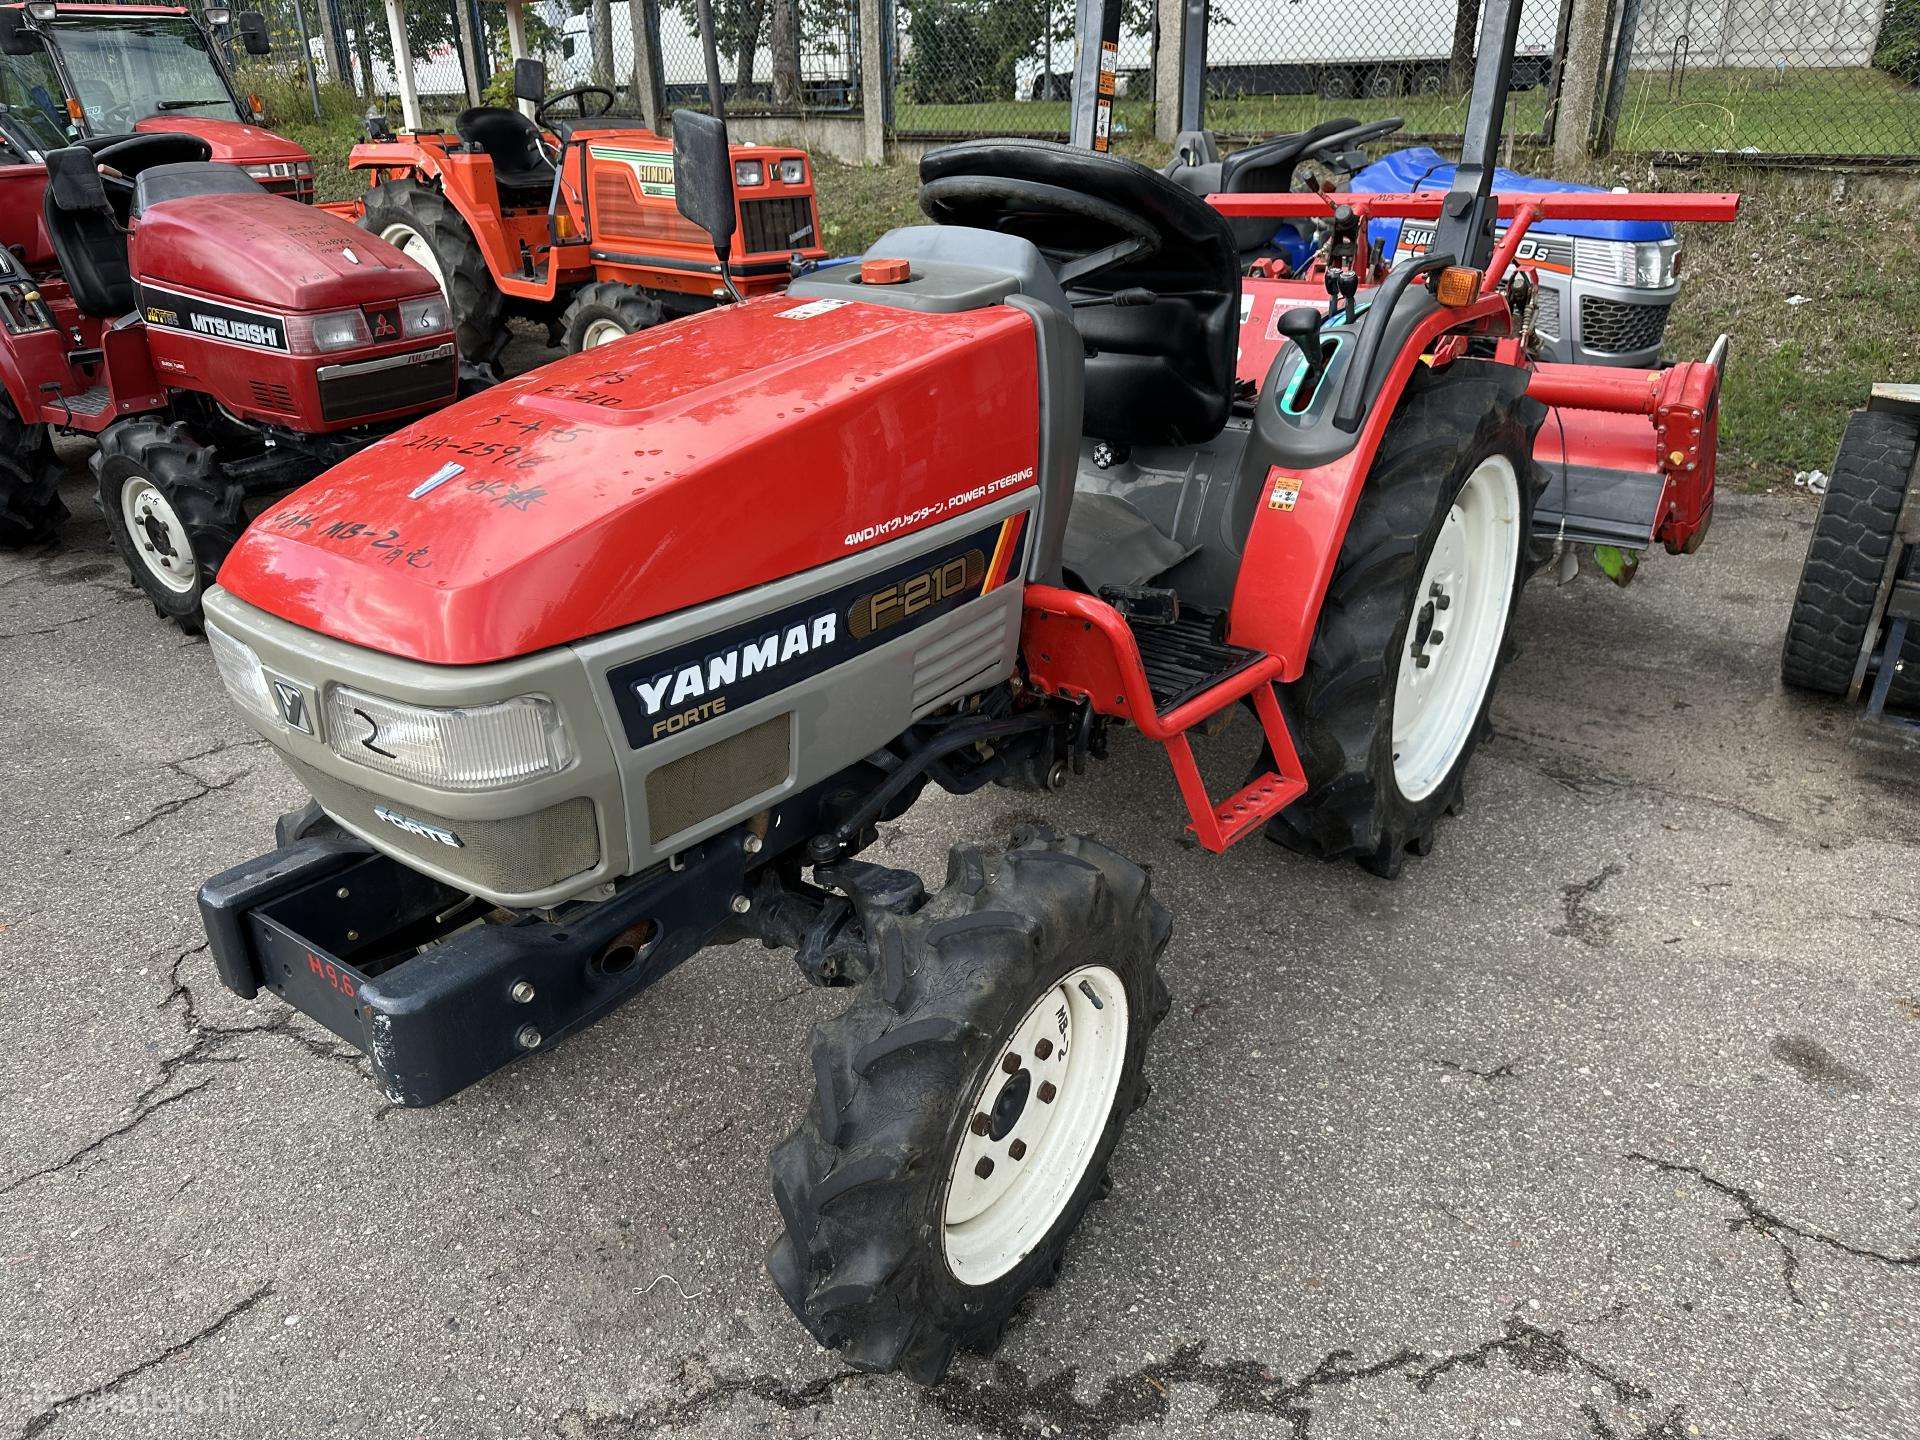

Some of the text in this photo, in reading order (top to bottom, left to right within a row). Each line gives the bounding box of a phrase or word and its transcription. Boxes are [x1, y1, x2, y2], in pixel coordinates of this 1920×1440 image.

[190, 312, 278, 347] MITSUBISHI
[948, 485, 986, 509] POWER
[987, 467, 1033, 494] STEERING
[636, 556, 968, 716] YANMAR F-210
[353, 707, 397, 758] 2
[652, 696, 726, 739] FORTE
[374, 805, 463, 848] FORTE
